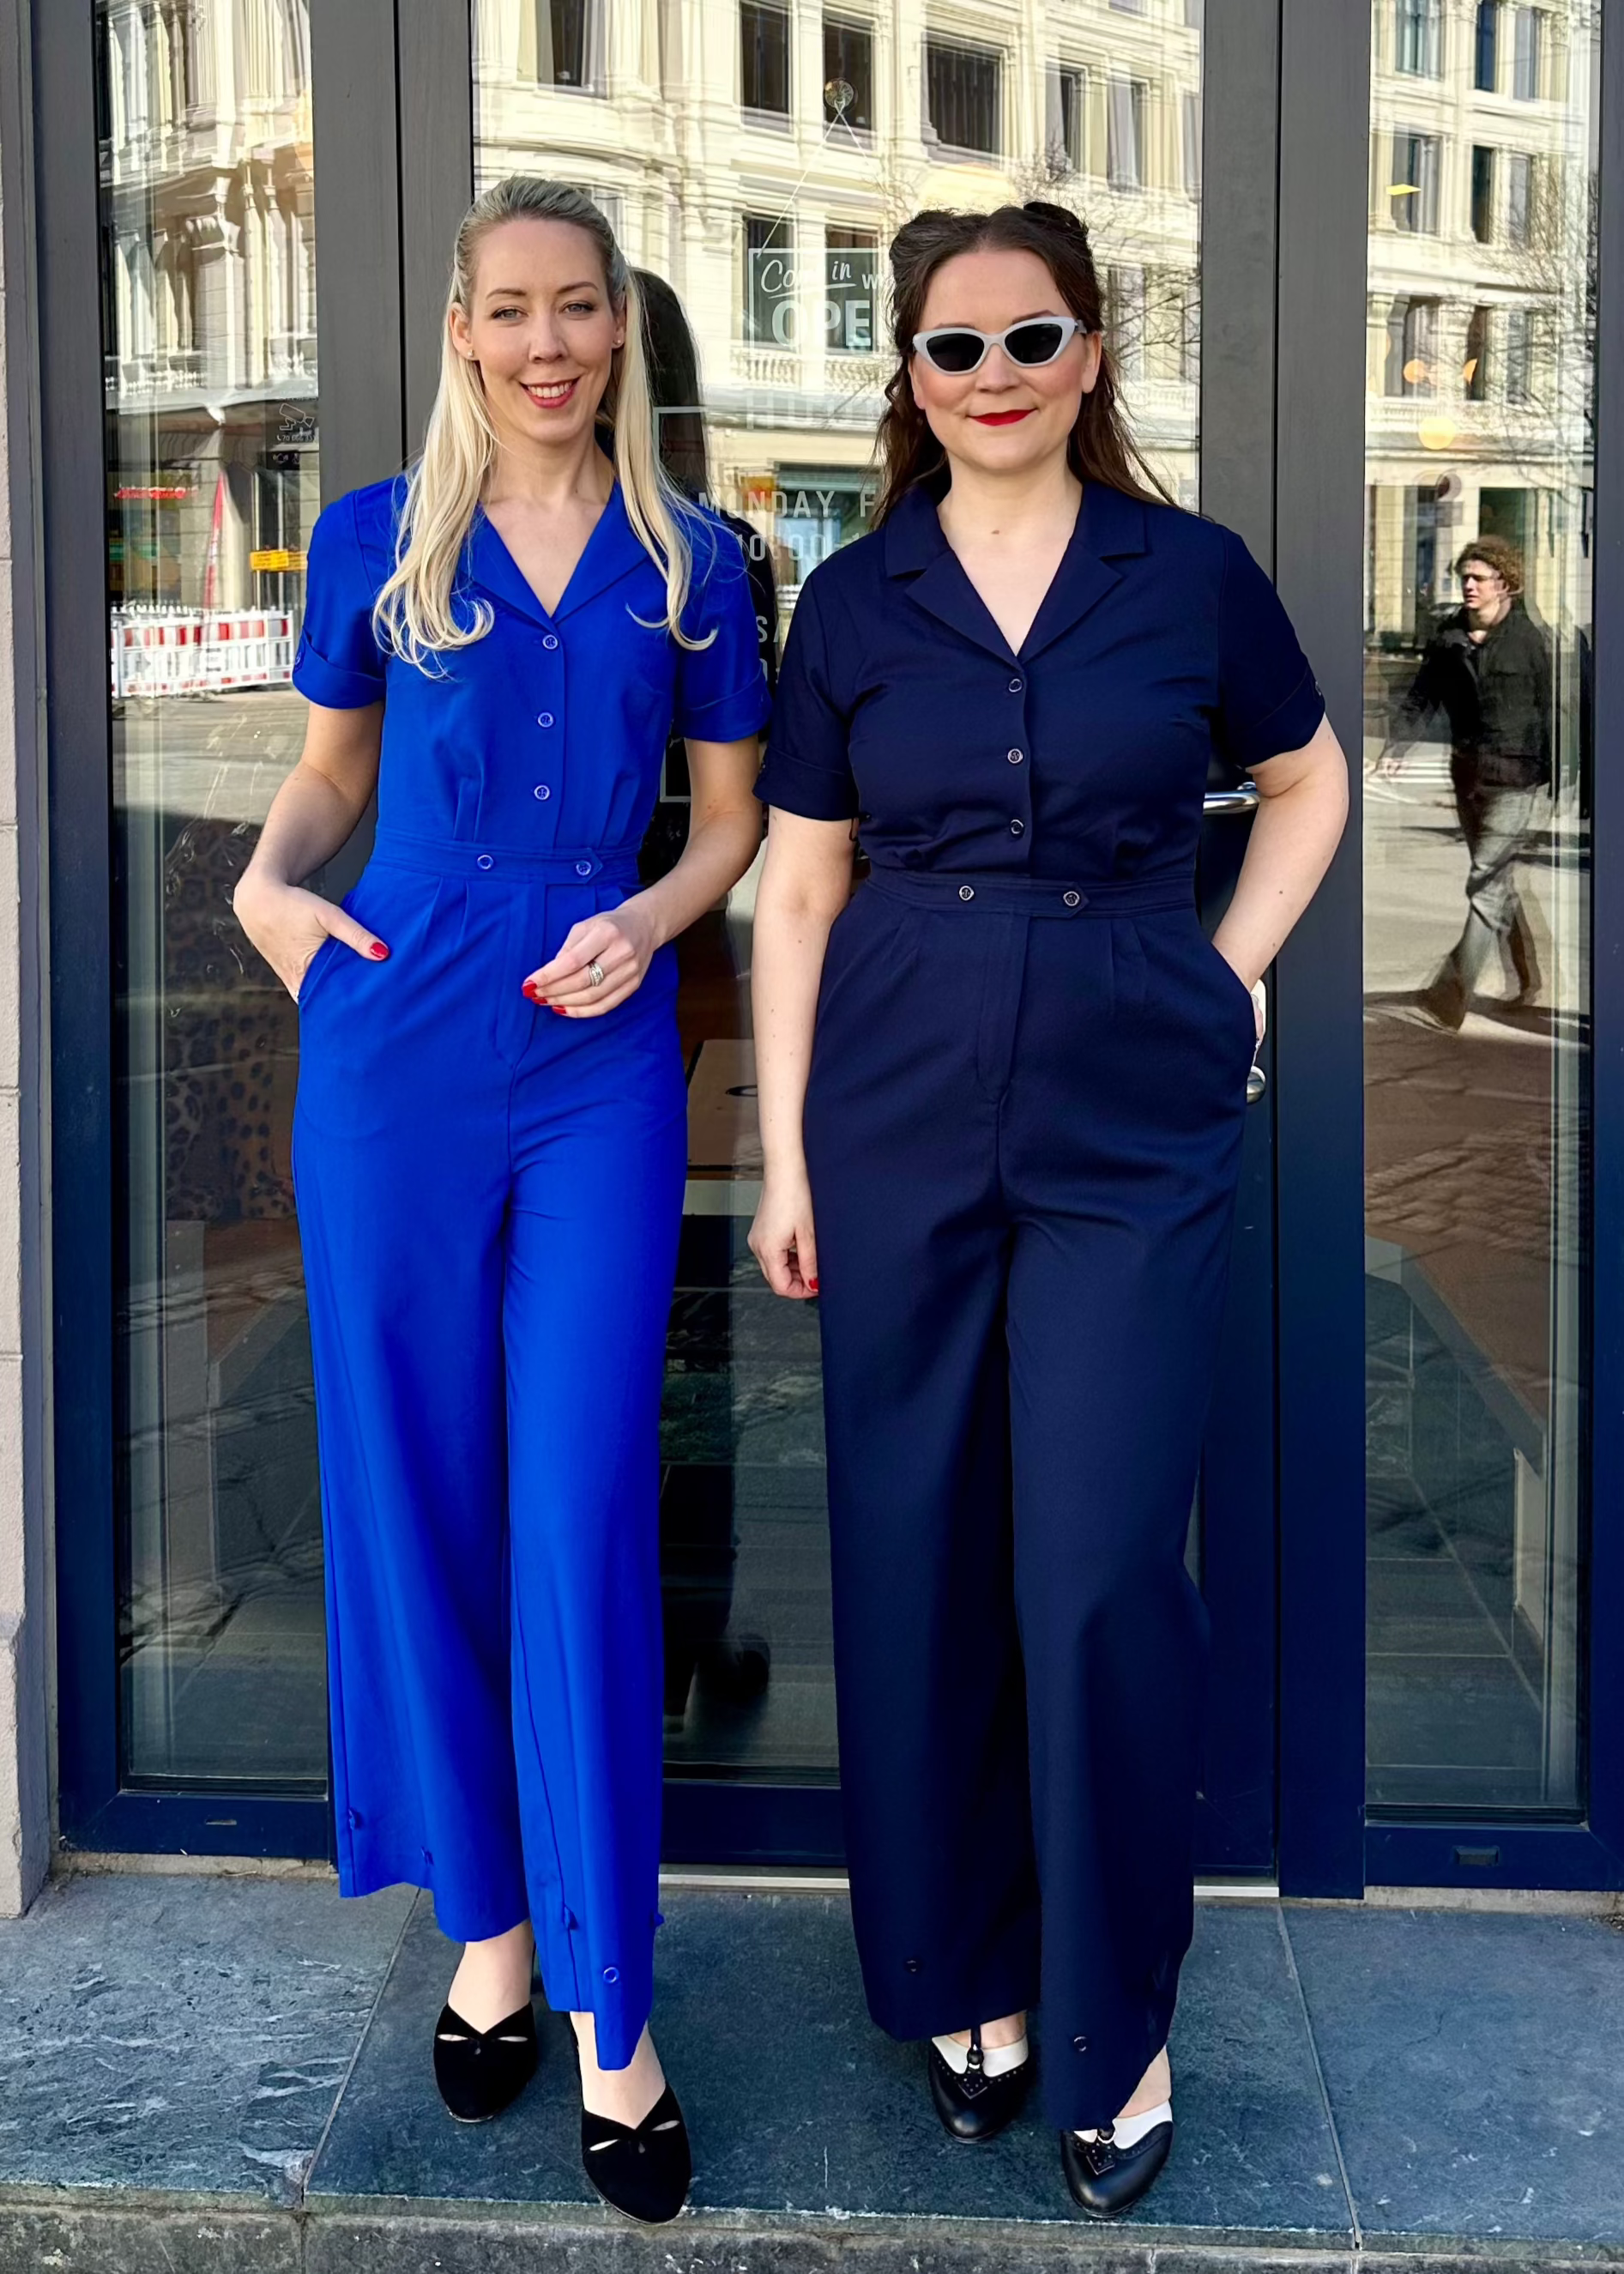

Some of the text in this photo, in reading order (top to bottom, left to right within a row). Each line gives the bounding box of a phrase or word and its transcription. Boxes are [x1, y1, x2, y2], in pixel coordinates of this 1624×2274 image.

[761, 259, 853, 293] Co in
[772, 299, 871, 347] OPE
[698, 491, 835, 518] MONDAY
